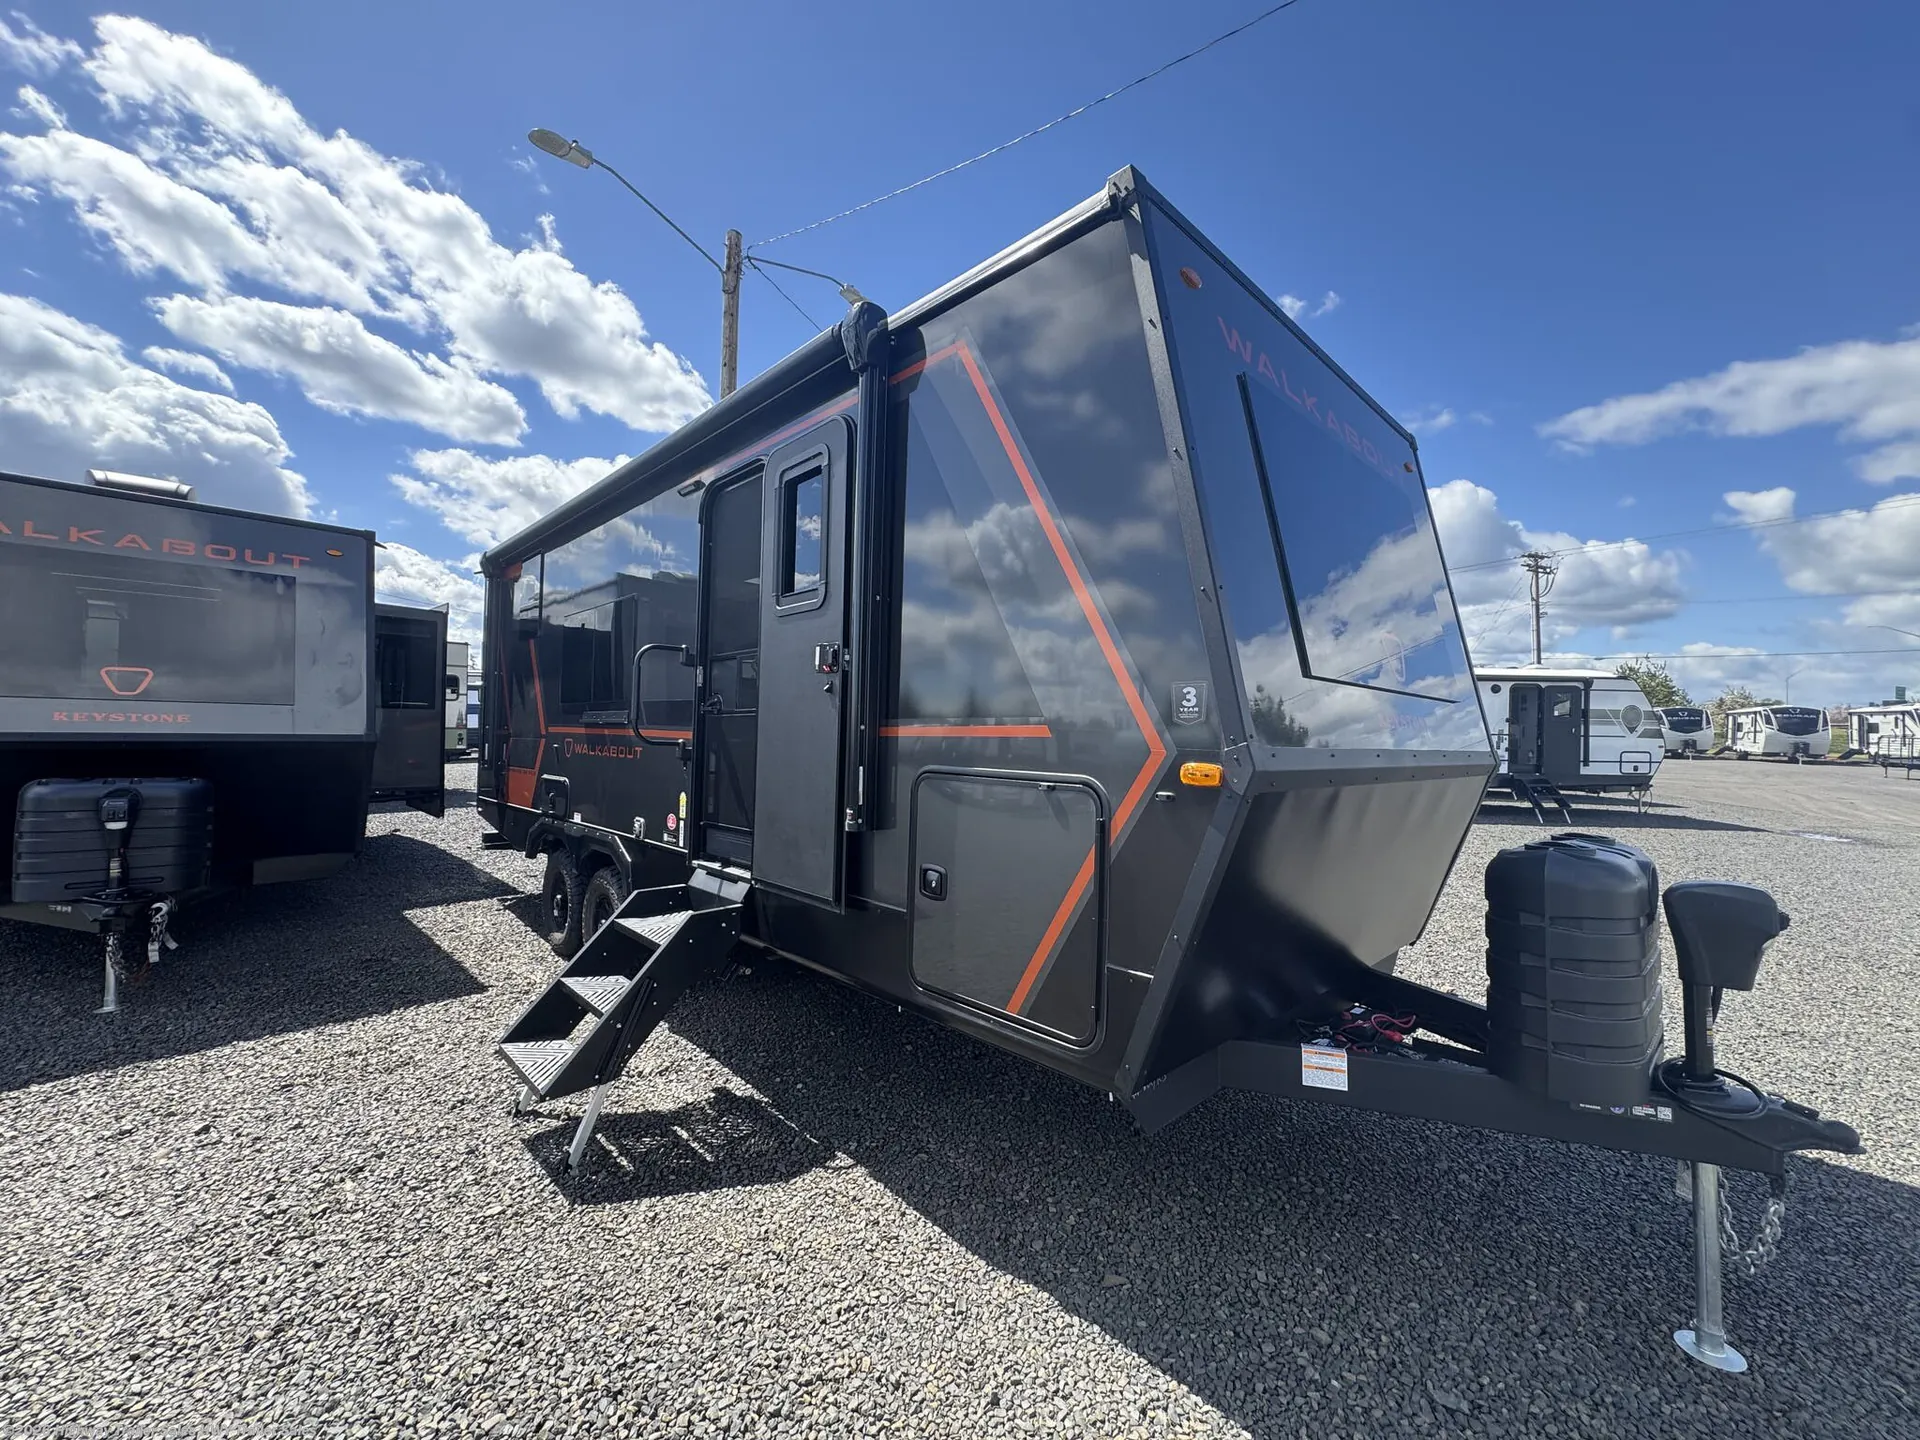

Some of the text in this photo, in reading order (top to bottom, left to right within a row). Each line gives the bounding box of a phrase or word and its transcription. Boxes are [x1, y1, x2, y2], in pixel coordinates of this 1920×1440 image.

[1182, 686, 1197, 706] 3
[52, 711, 192, 723] KEYSTONE
[574, 743, 643, 759] WALKABOUT
